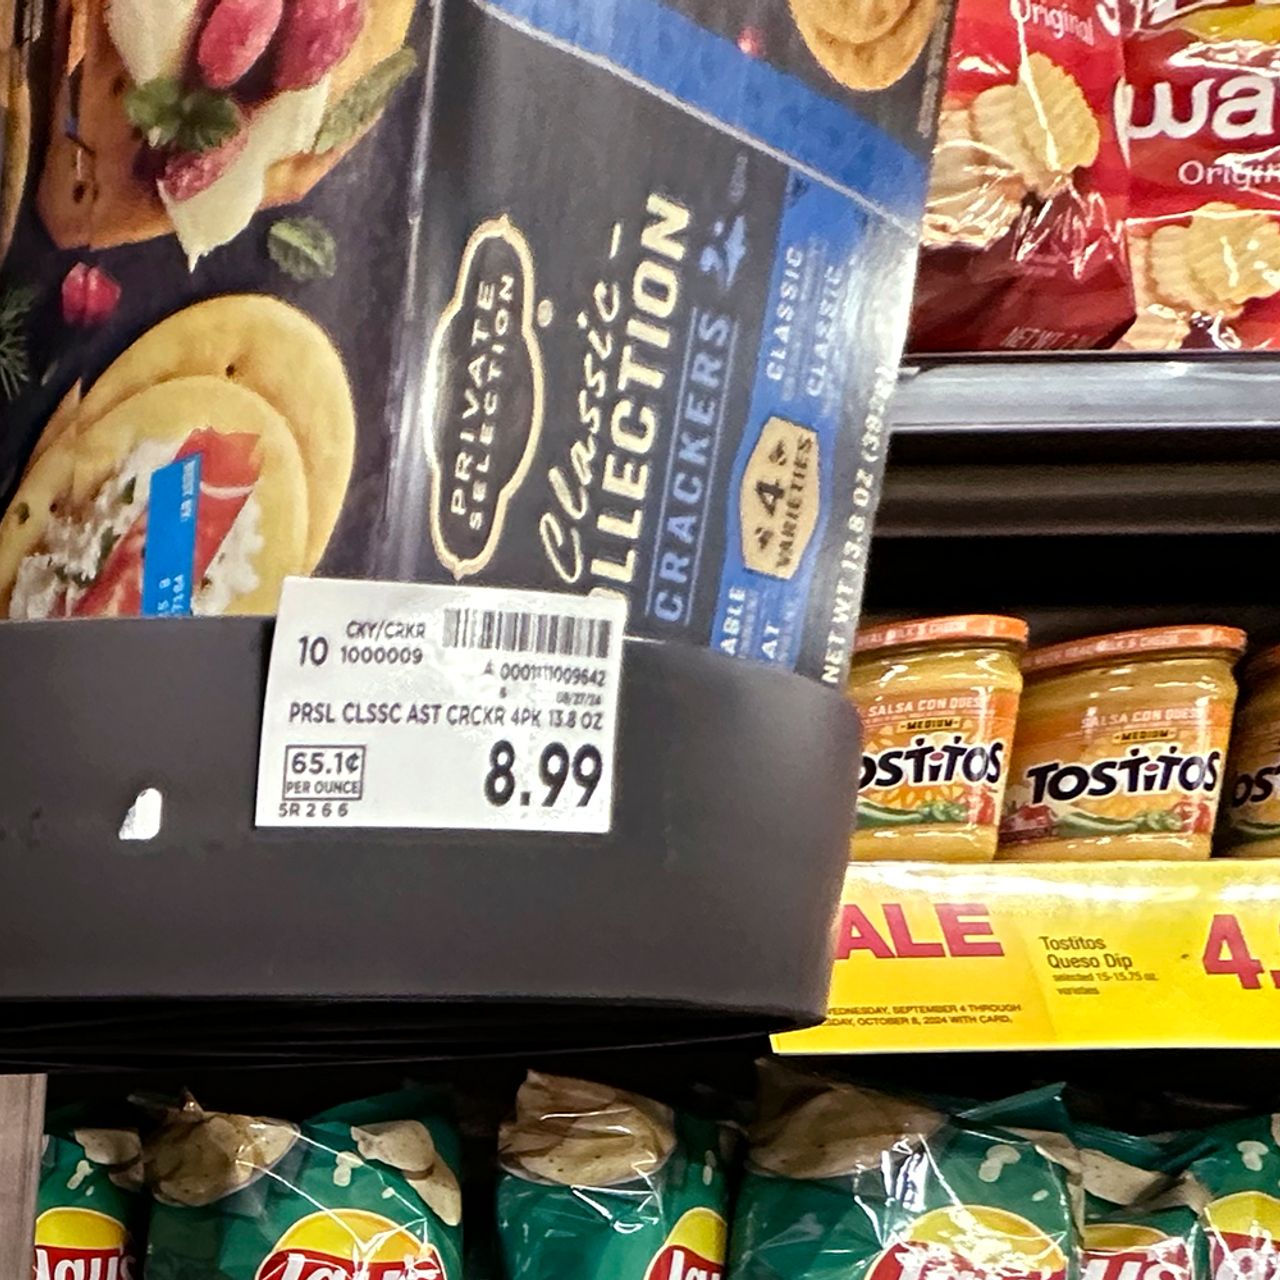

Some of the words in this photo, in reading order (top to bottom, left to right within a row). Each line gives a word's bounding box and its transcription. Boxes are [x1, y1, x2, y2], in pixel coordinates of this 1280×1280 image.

[766, 246, 803, 382] CLASSIC
[451, 280, 496, 516] PRIVATE
[469, 273, 514, 531] SELECTION
[540, 280, 621, 584] Classic
[653, 311, 732, 624] CRACKERS
[775, 435, 815, 570] VARIETIES
[297, 635, 330, 667] 10
[340, 645, 424, 666] 1000009
[289, 702, 336, 725] PRSL
[342, 703, 403, 726] CLSSC
[406, 704, 442, 726] AST
[446, 705, 506, 727] CRCKR
[511, 707, 541, 728] 4PK
[580, 710, 604, 731] OZ
[868, 699, 915, 718] SALSA
[917, 697, 947, 713] CON
[948, 695, 985, 710] QUES
[286, 780, 312, 795] PER
[313, 780, 361, 796] OUNCE
[483, 738, 604, 809] 8.99
[835, 902, 1006, 960] ALE
[1039, 935, 1107, 952] Tostitos
[1047, 954, 1101, 971] Queso
[1104, 953, 1134, 971] Dip
